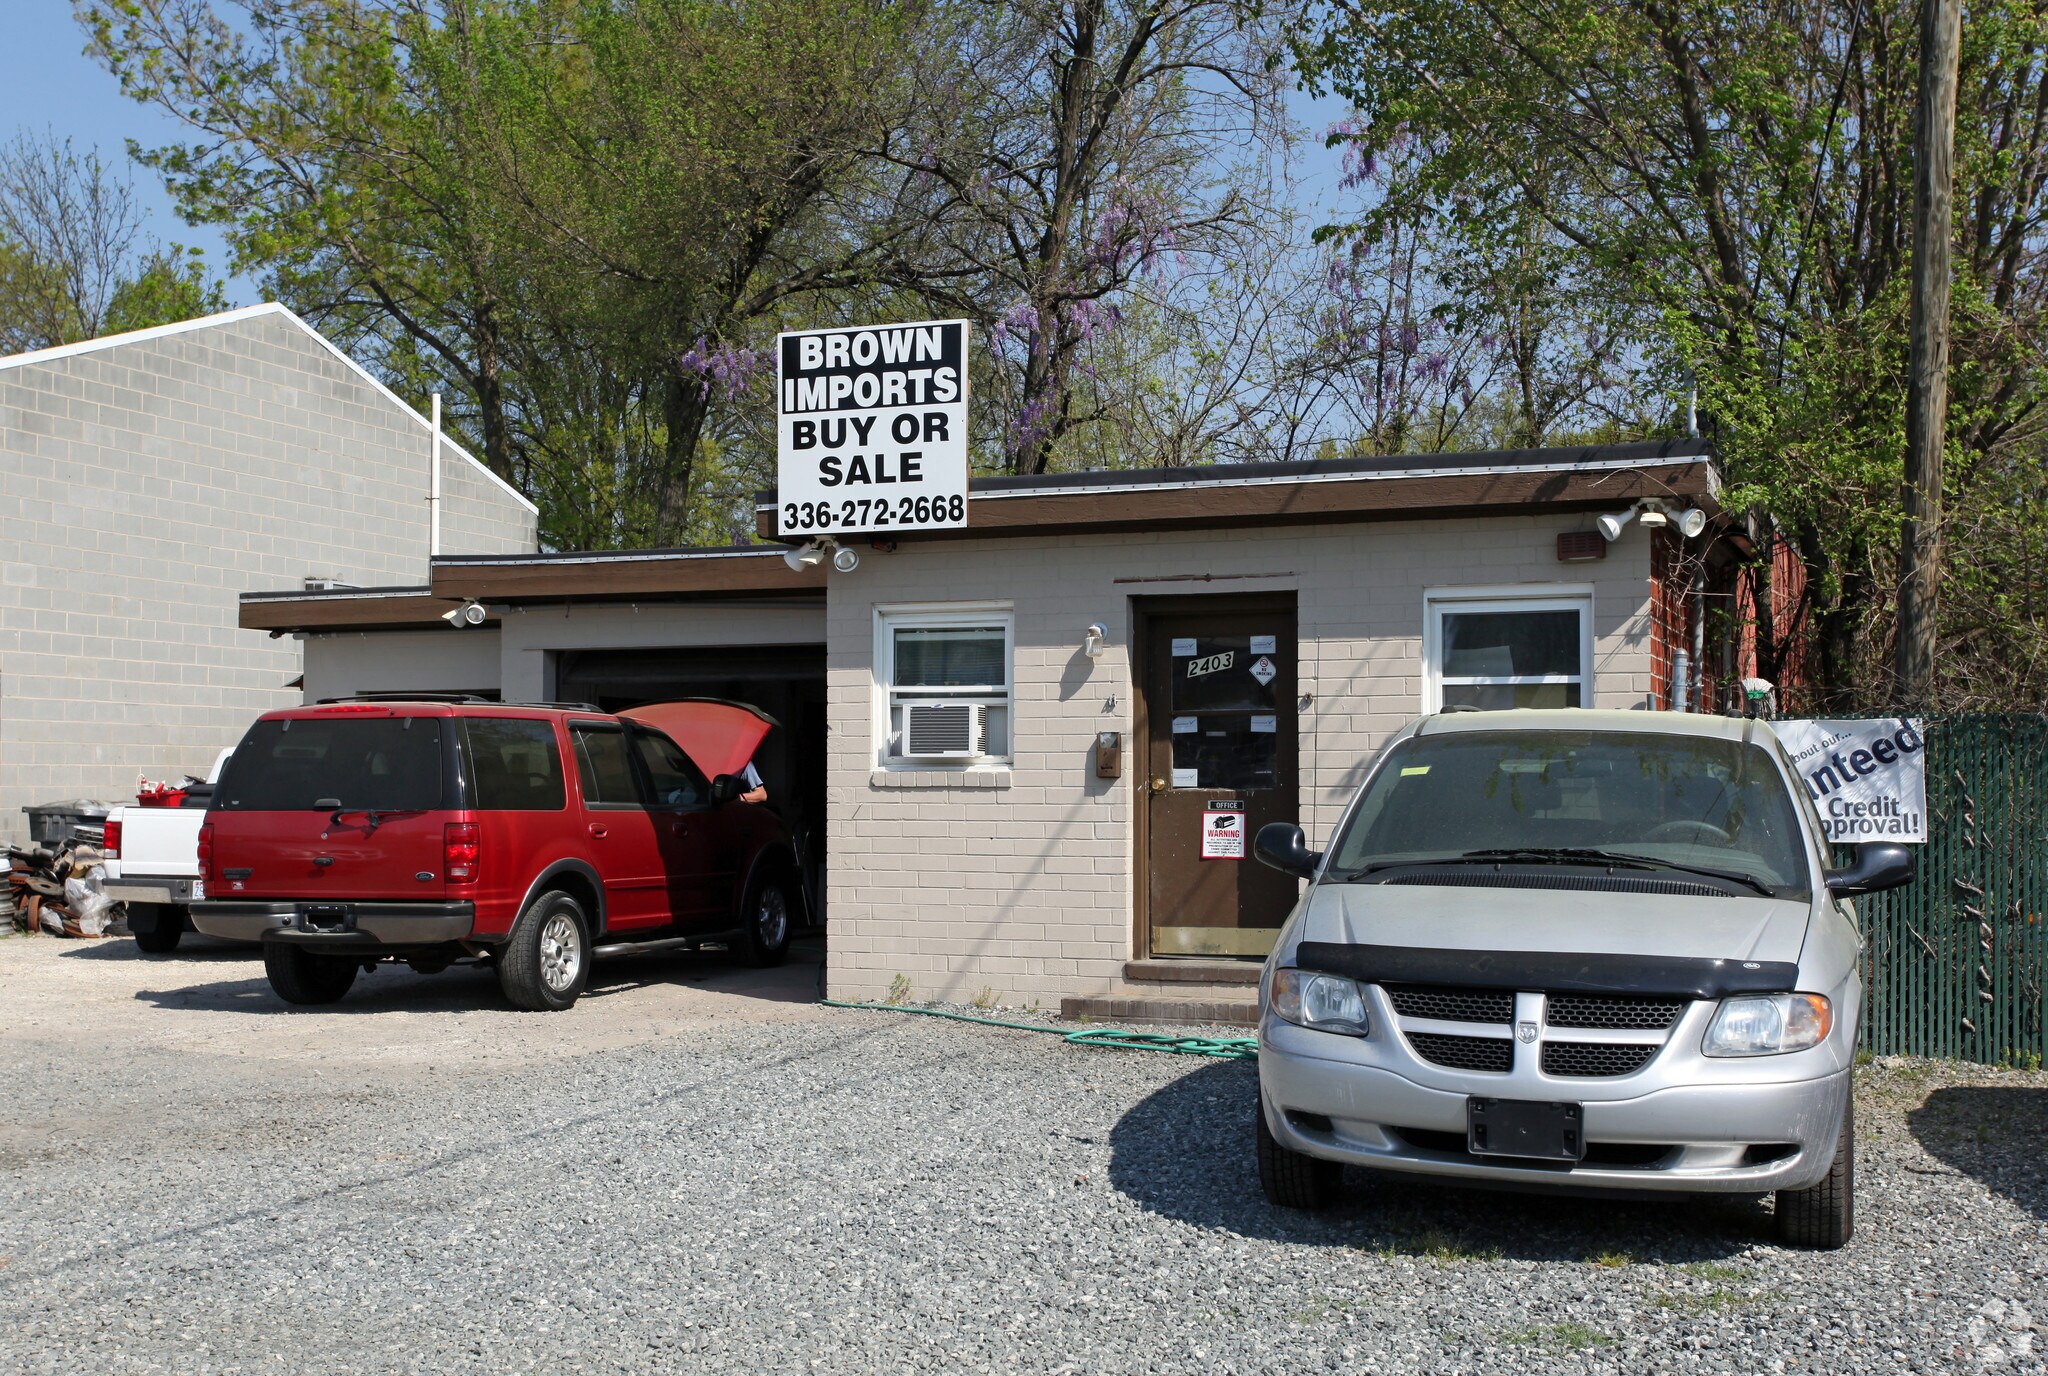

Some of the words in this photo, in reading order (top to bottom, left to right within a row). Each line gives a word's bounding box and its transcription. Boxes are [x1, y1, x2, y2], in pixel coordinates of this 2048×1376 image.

[800, 327, 942, 370] BROWN
[785, 367, 957, 412] IMPORTS
[793, 416, 877, 450] BUY
[892, 412, 949, 445] OR
[819, 452, 923, 487] SALE
[784, 495, 964, 529] 336-272-2668
[1189, 653, 1232, 676] 2403
[1821, 732, 1852, 747] our...
[1828, 796, 1900, 817] Credit
[1208, 830, 1240, 838] WARNING
